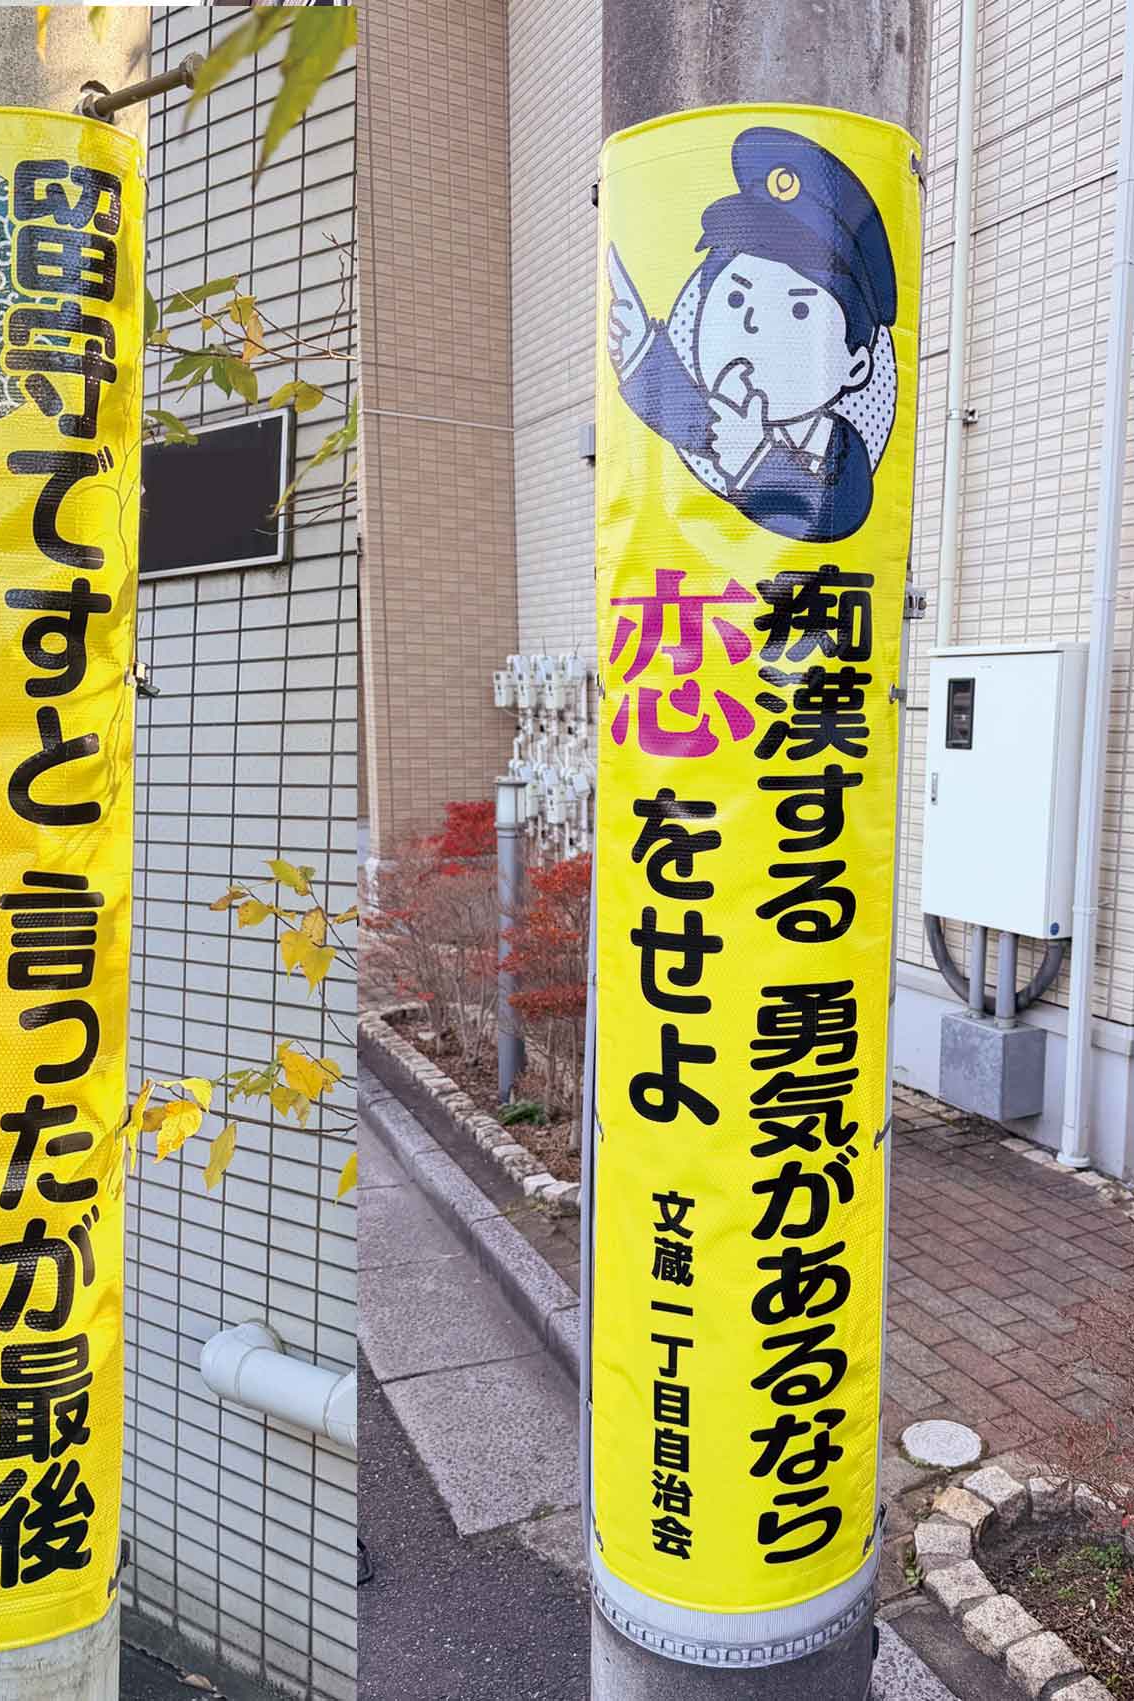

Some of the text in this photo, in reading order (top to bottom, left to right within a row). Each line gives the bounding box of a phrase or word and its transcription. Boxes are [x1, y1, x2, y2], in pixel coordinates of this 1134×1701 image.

[650, 1188, 696, 1562] 文蔵一丁目自治会
